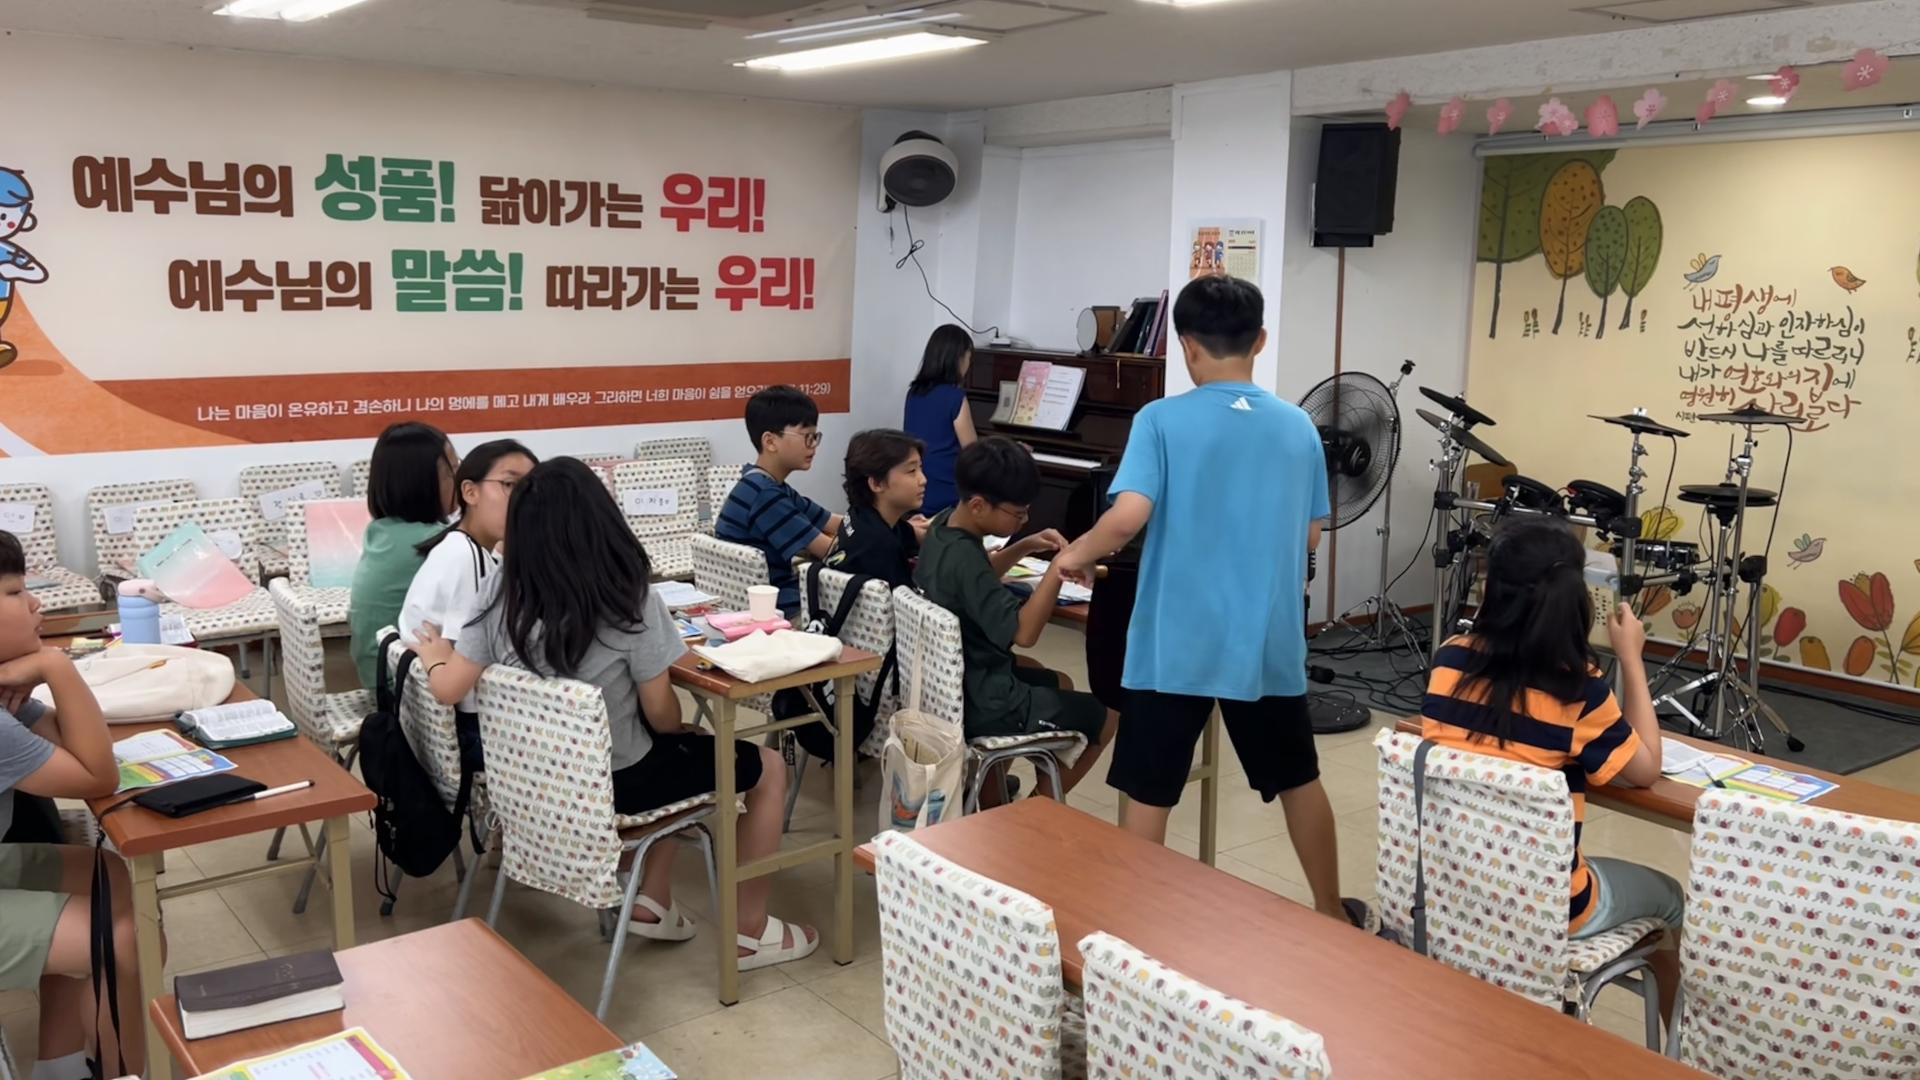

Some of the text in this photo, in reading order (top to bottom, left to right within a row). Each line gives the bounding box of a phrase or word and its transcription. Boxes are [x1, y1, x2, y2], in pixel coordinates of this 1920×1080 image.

[72, 153, 765, 232] 예수님의 성품! 닮아가는 우리!
[168, 249, 815, 312] 예수님의 말씀! 따라가는 우리!
[1677, 305, 1865, 341] 선하심과 인자하심이
[1684, 336, 1865, 366] 반드시 나를 따르리니
[1679, 362, 1856, 404] 내가 여호와의 집에
[1680, 384, 1736, 407] 영원히
[197, 406, 231, 421] 나는
[235, 403, 283, 419] 마음이
[288, 401, 349, 417] 온유하고
[353, 398, 411, 415] 겸손하니
[416, 397, 444, 411] 나의
[448, 395, 489, 411] 멍에를
[493, 395, 520, 408] 메고
[523, 393, 549, 407] 내게
[553, 392, 591, 406] 배우라
[594, 390, 643, 404] 그리하면
[646, 388, 669, 402] 너희
[672, 387, 706, 400] 마음이
